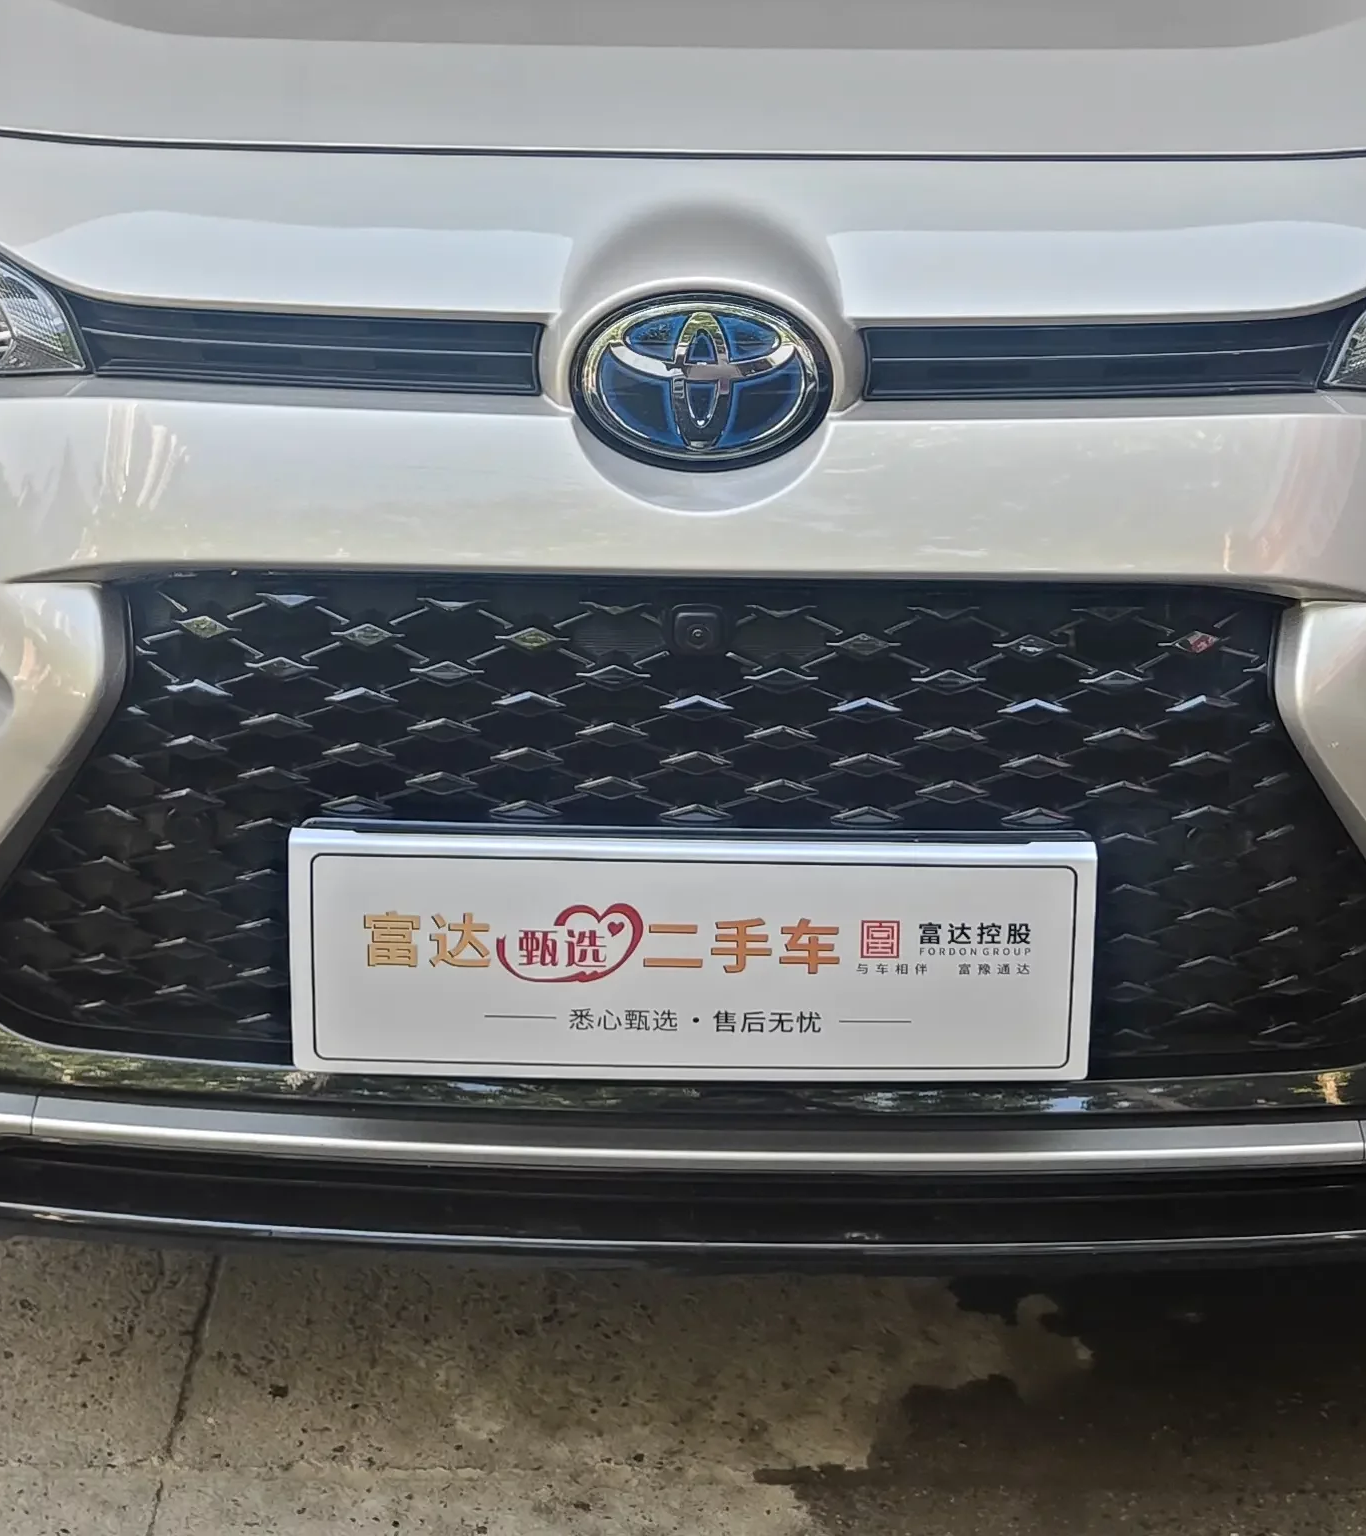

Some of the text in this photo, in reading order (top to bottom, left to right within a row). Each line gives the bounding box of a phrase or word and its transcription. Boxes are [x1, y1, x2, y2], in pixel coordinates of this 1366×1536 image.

[363, 910, 840, 974] 富达 甄选 二手车
[919, 922, 1031, 945] 富达控股
[856, 963, 1030, 976] 与车相伴 富豫通达
